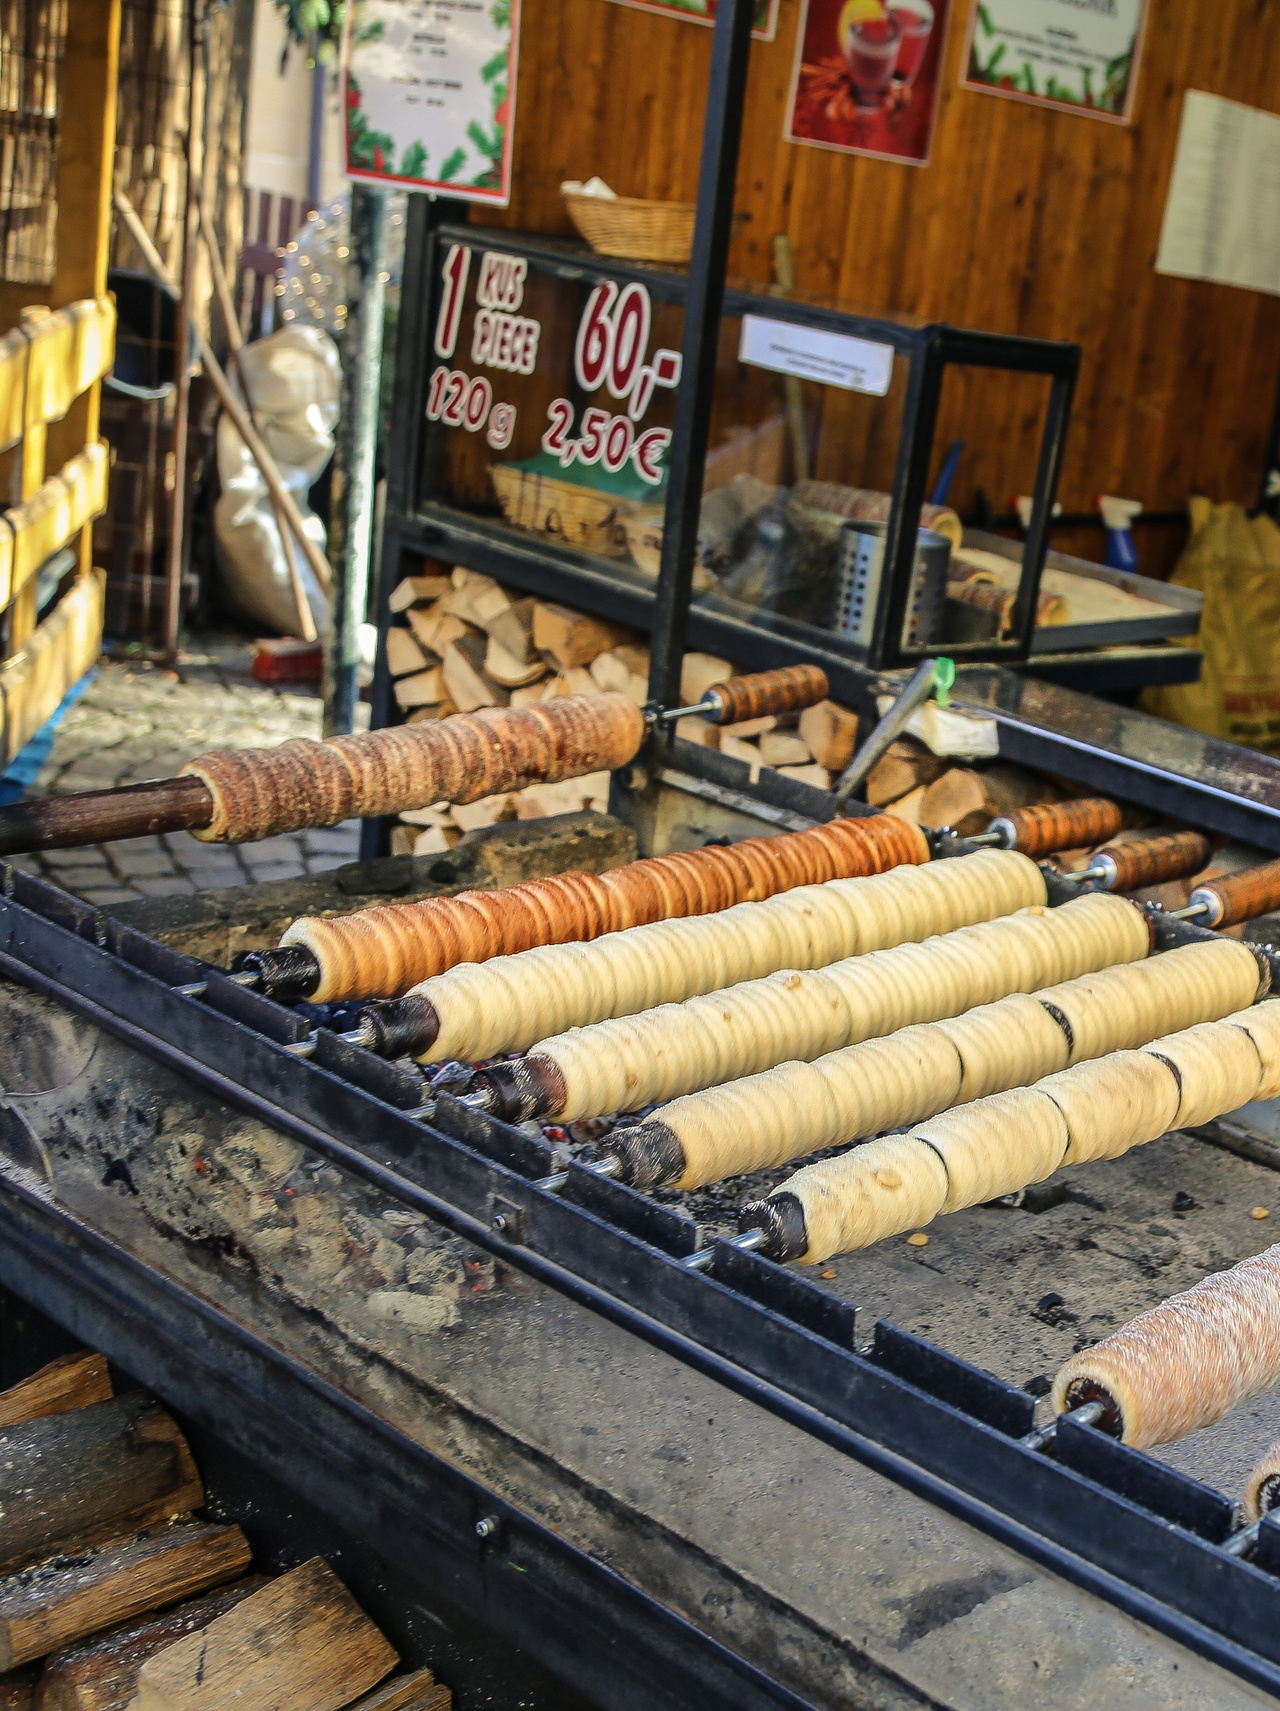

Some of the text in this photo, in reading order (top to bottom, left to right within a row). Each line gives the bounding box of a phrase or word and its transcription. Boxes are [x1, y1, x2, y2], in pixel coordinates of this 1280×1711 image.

[435, 245, 527, 358] 1 KUS
[471, 308, 541, 375] PIECE
[426, 366, 516, 449] 120 g
[542, 398, 673, 485] 2,50€
